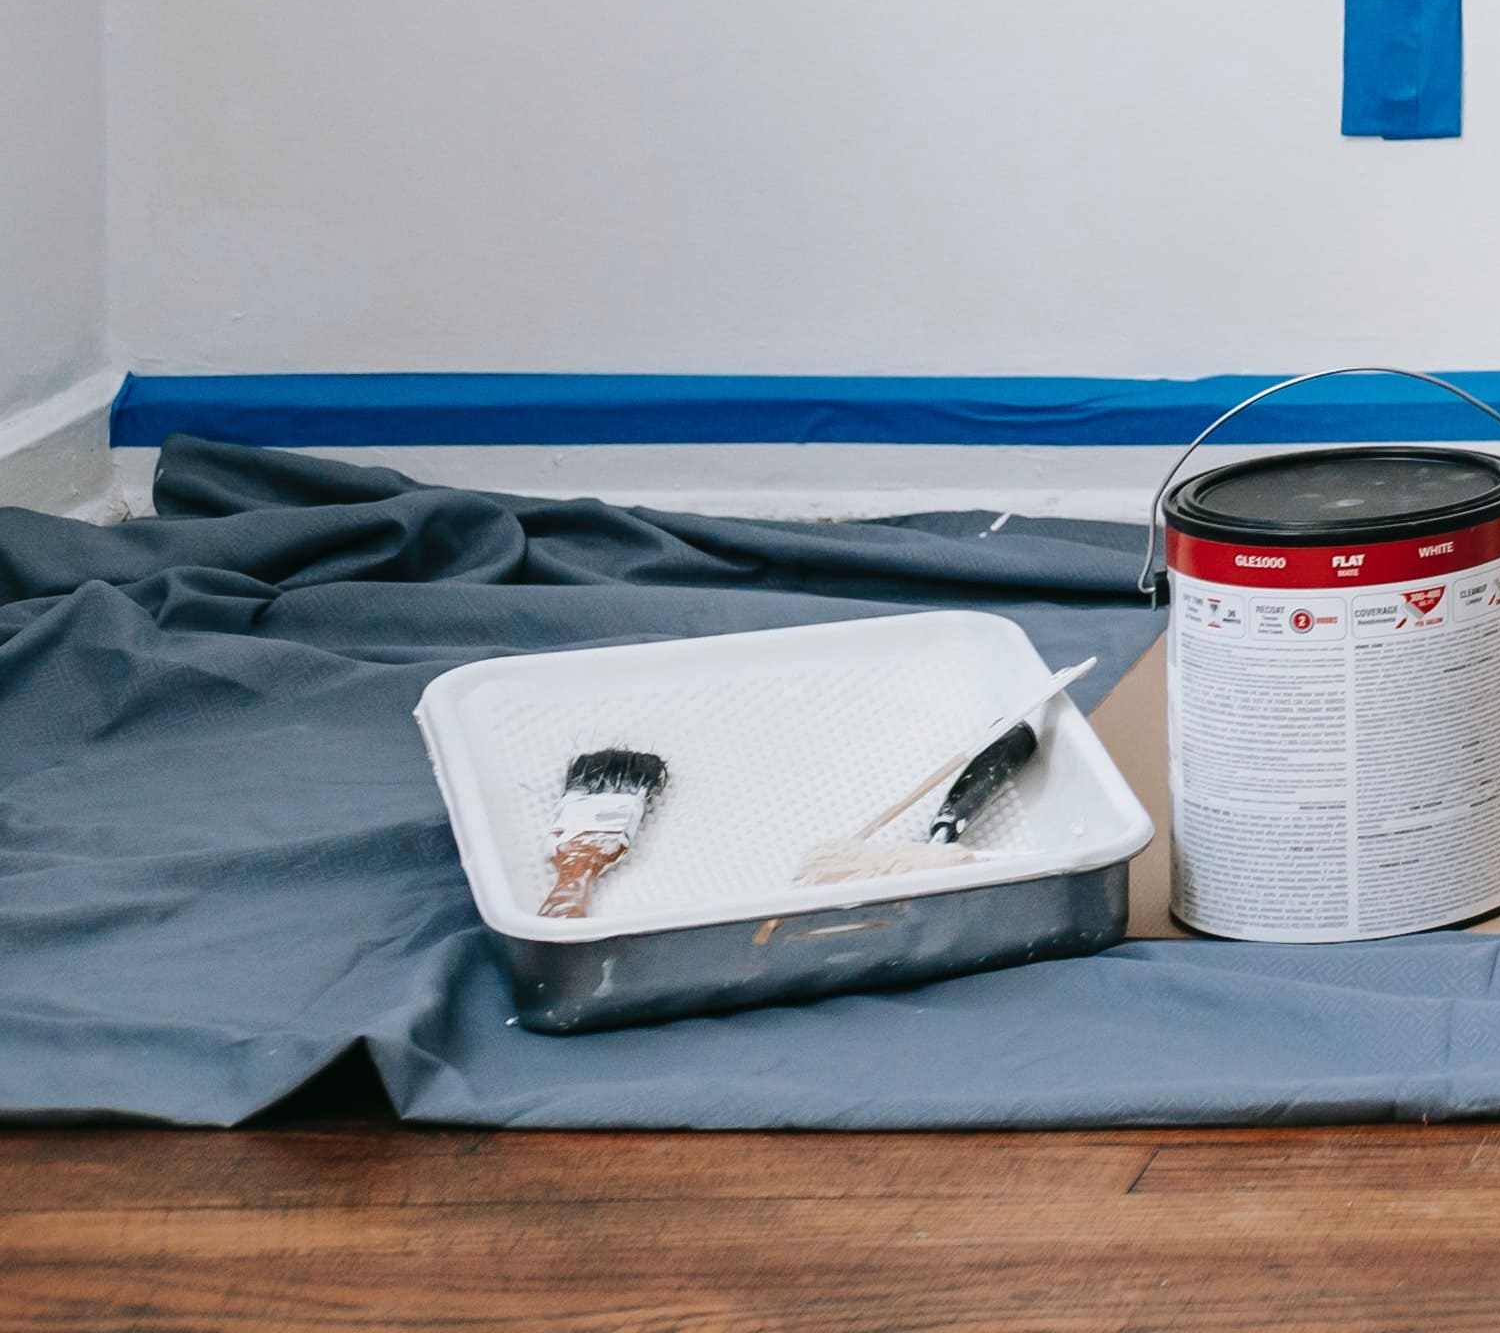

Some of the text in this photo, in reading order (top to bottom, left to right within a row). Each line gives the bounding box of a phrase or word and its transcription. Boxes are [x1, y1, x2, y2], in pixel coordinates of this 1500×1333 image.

[1235, 541, 1454, 569] GLE1000 FLAT WHITE
[1354, 605, 1398, 618] COVERAGE
